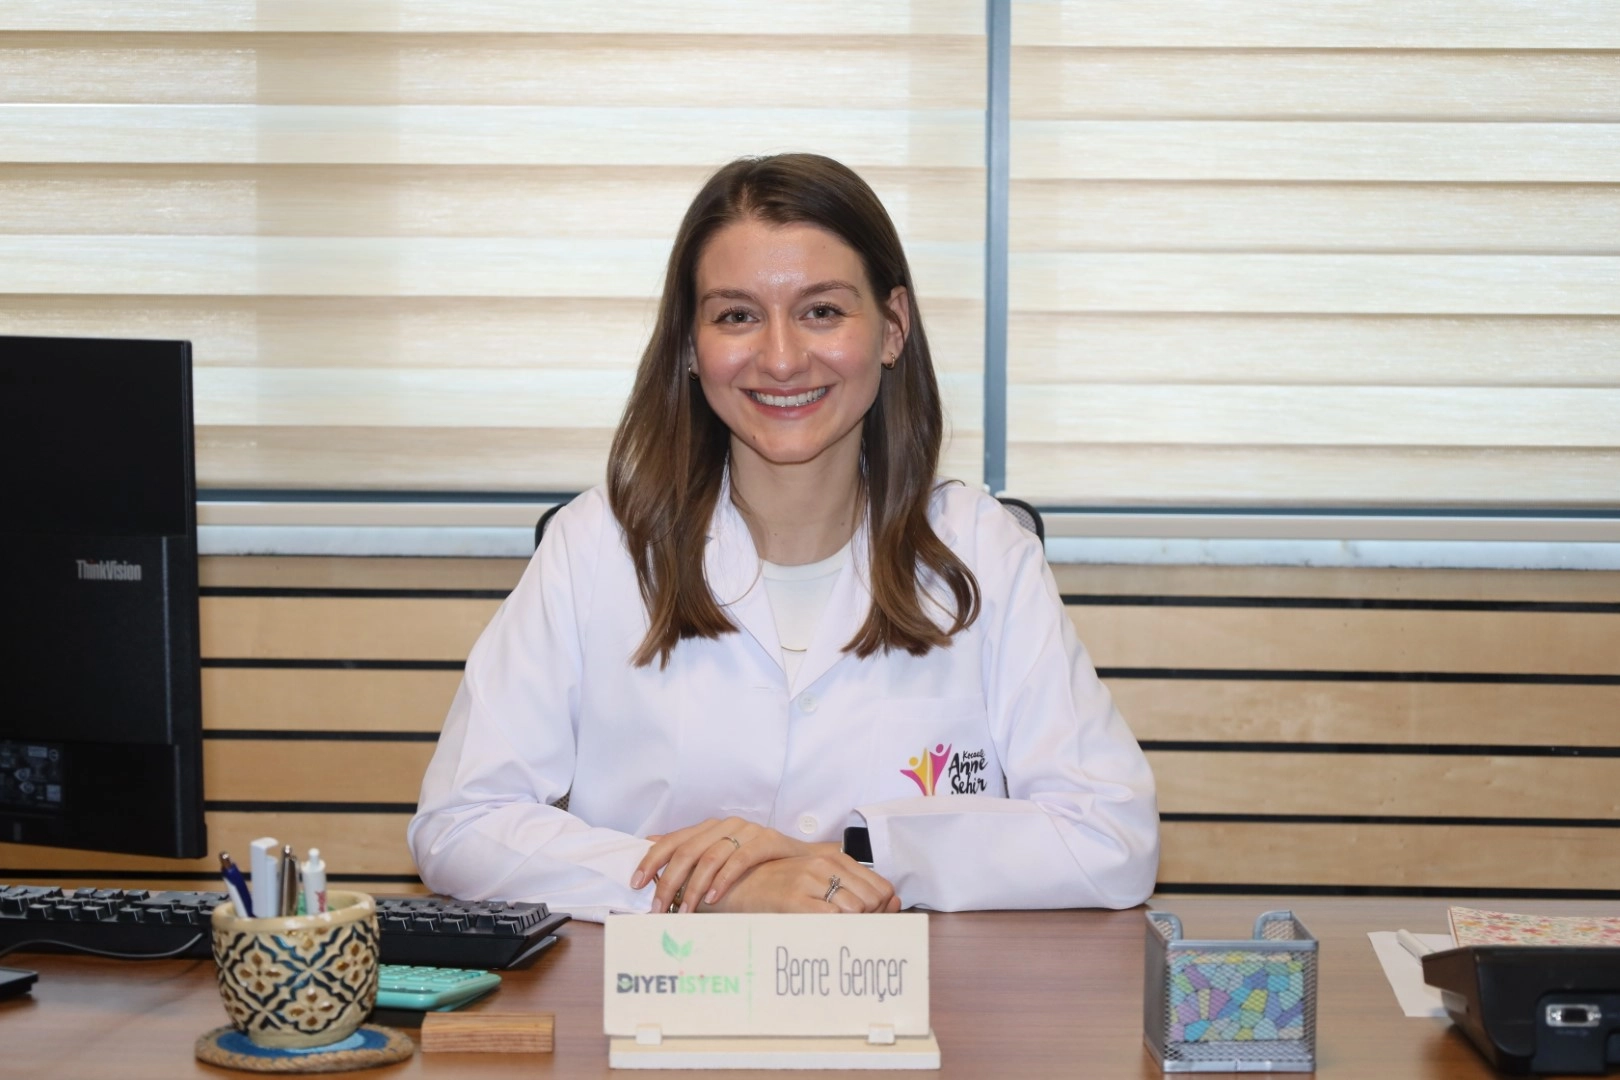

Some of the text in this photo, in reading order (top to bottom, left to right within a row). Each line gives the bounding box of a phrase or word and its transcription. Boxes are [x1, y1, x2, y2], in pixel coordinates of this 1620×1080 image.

[76, 559, 142, 581] ThinkVision
[948, 752, 988, 778] Anne
[776, 946, 908, 1002] Berre Gençer
